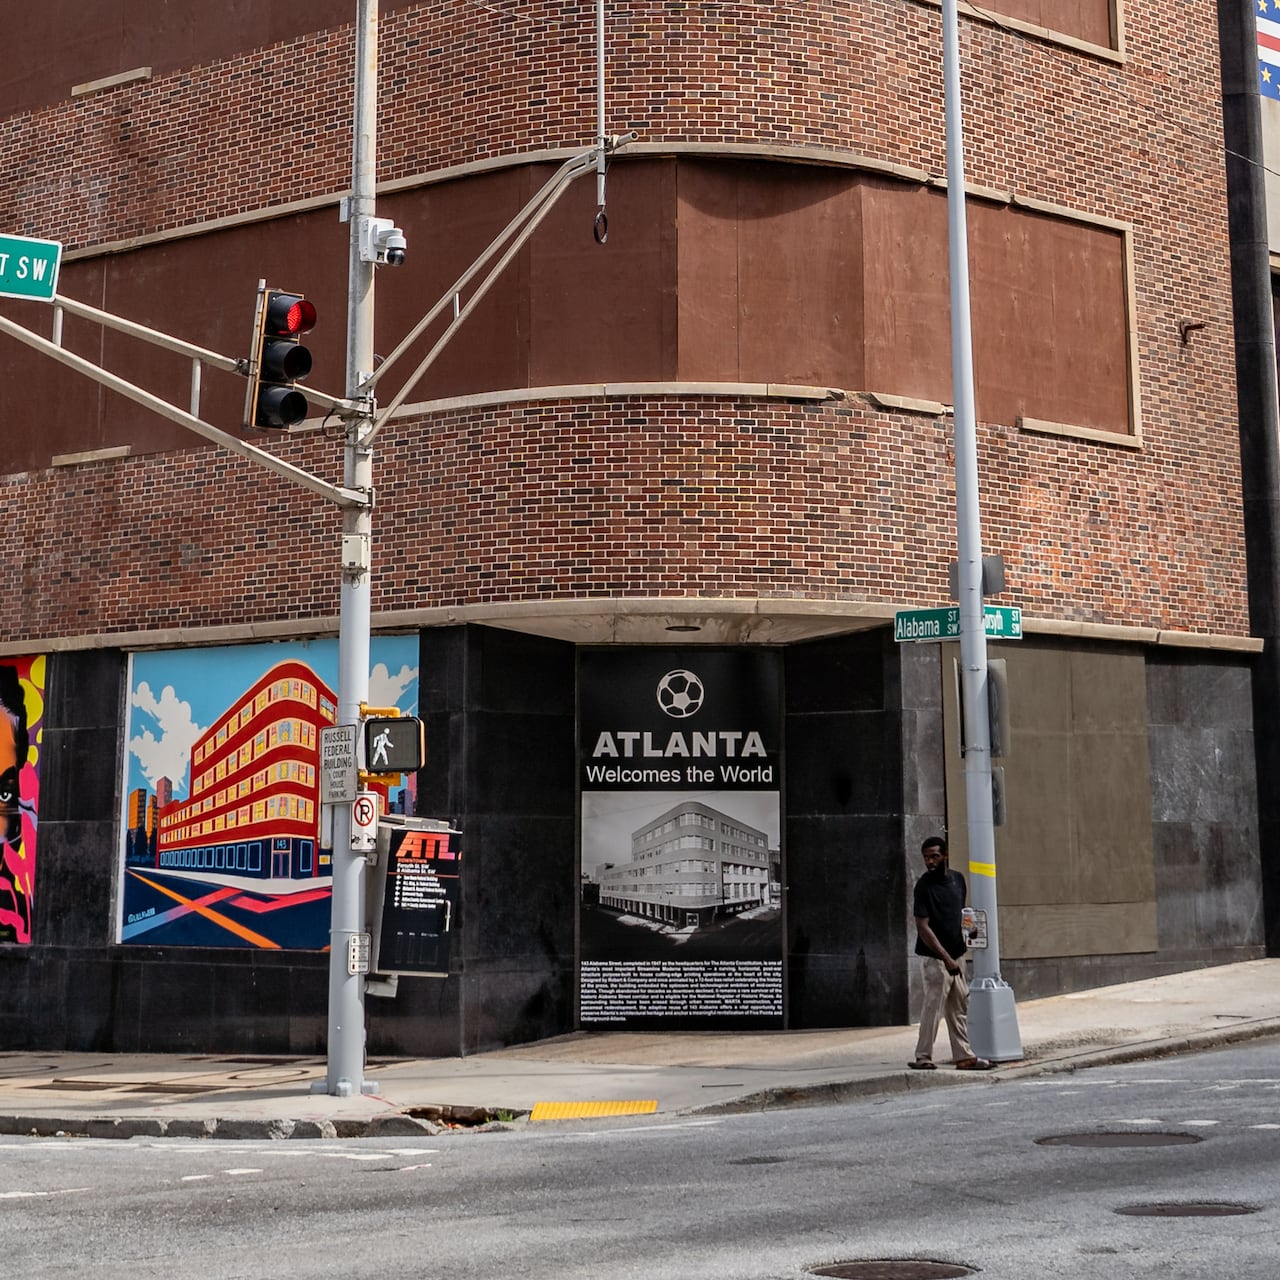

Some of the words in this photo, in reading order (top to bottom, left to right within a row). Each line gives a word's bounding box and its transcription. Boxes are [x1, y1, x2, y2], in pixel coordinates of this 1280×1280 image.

[16, 255, 48, 281] SW
[948, 610, 957, 622] ST
[1011, 610, 1019, 622] ST
[896, 616, 940, 638] Alabama
[947, 623, 958, 635] SW
[1011, 622, 1020, 634] SW
[324, 730, 352, 743] RUSSELL
[324, 744, 351, 757] FEDERAL
[592, 731, 768, 758] ATLANTA
[324, 756, 352, 770] BUILDING
[333, 770, 347, 778] COURT
[586, 765, 681, 783] Welcomes
[686, 765, 715, 783] the
[720, 765, 773, 783] World
[330, 780, 345, 789] HOUSE
[329, 790, 347, 798] PARKING
